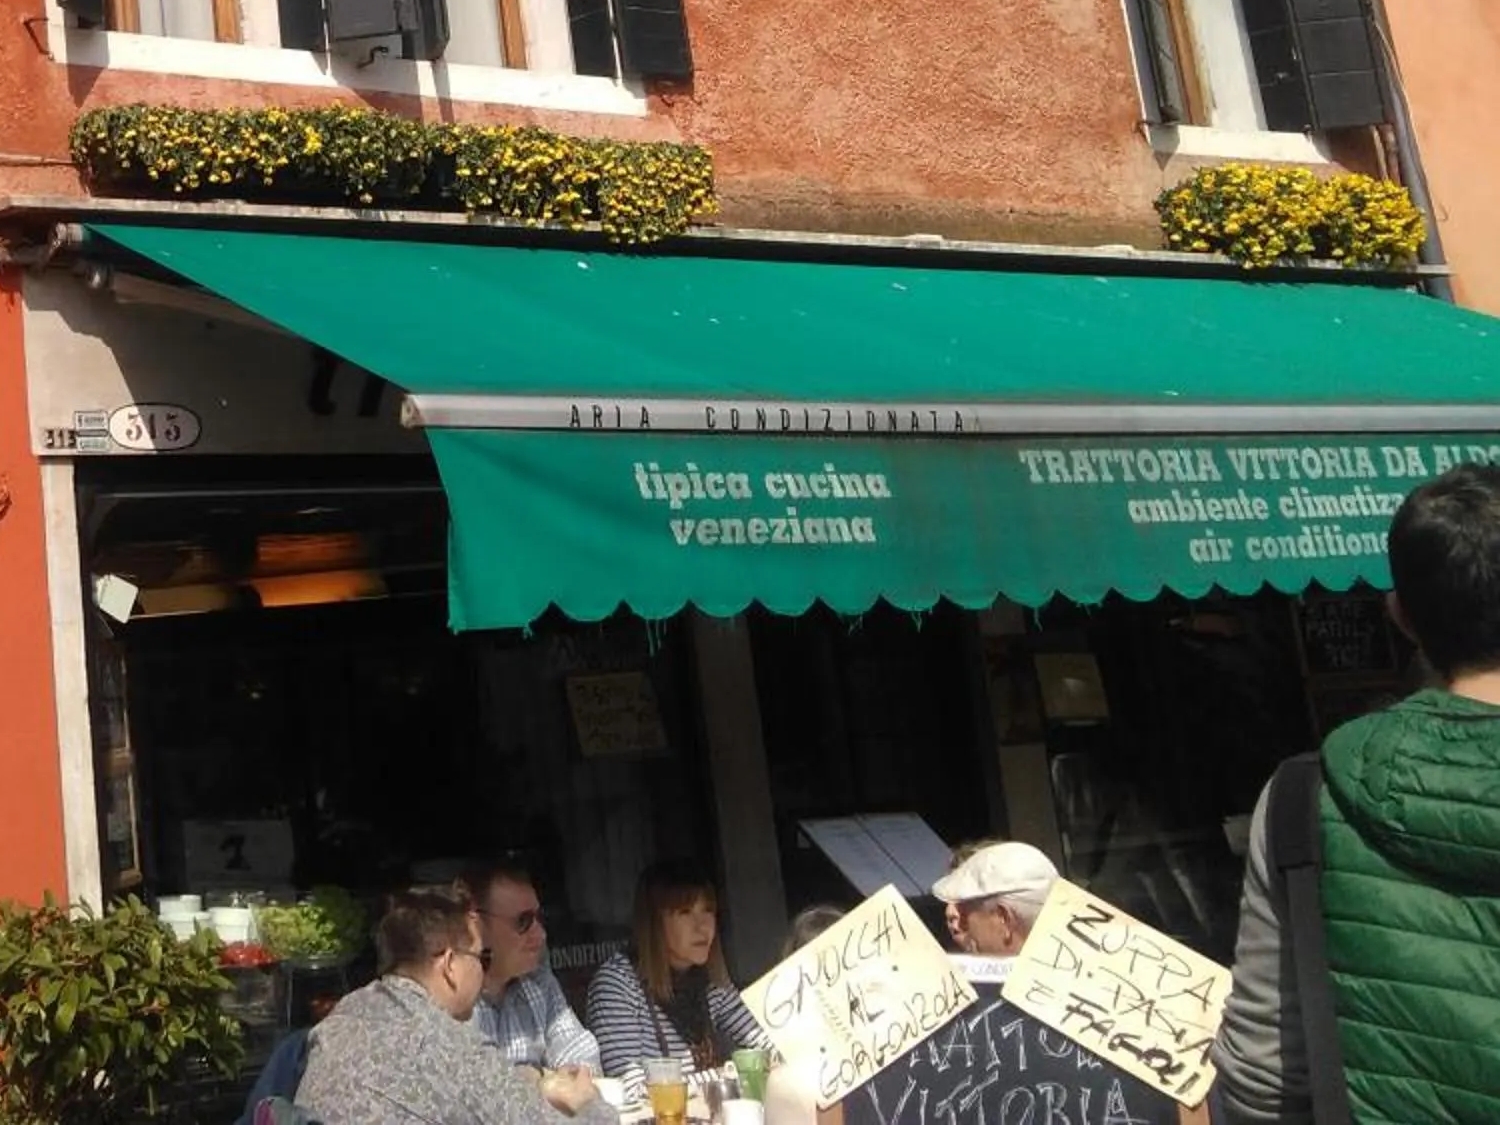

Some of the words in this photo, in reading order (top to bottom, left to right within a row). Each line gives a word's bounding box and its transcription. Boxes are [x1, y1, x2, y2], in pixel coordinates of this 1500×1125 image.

[569, 405, 651, 429] ARIA
[705, 406, 964, 432] CONDIZIONATA
[1019, 448, 1222, 484] TRATTORIA
[1225, 446, 1378, 481] VITTORIA
[1380, 446, 1428, 476] DA
[633, 462, 752, 508] tipica
[765, 463, 891, 499] cucina
[1128, 488, 1269, 524] ambiente
[670, 507, 877, 546] veneziana
[1189, 531, 1234, 562] air
[763, 903, 907, 1029] GNOCCHI
[1066, 904, 1216, 1012] ZUPPA
